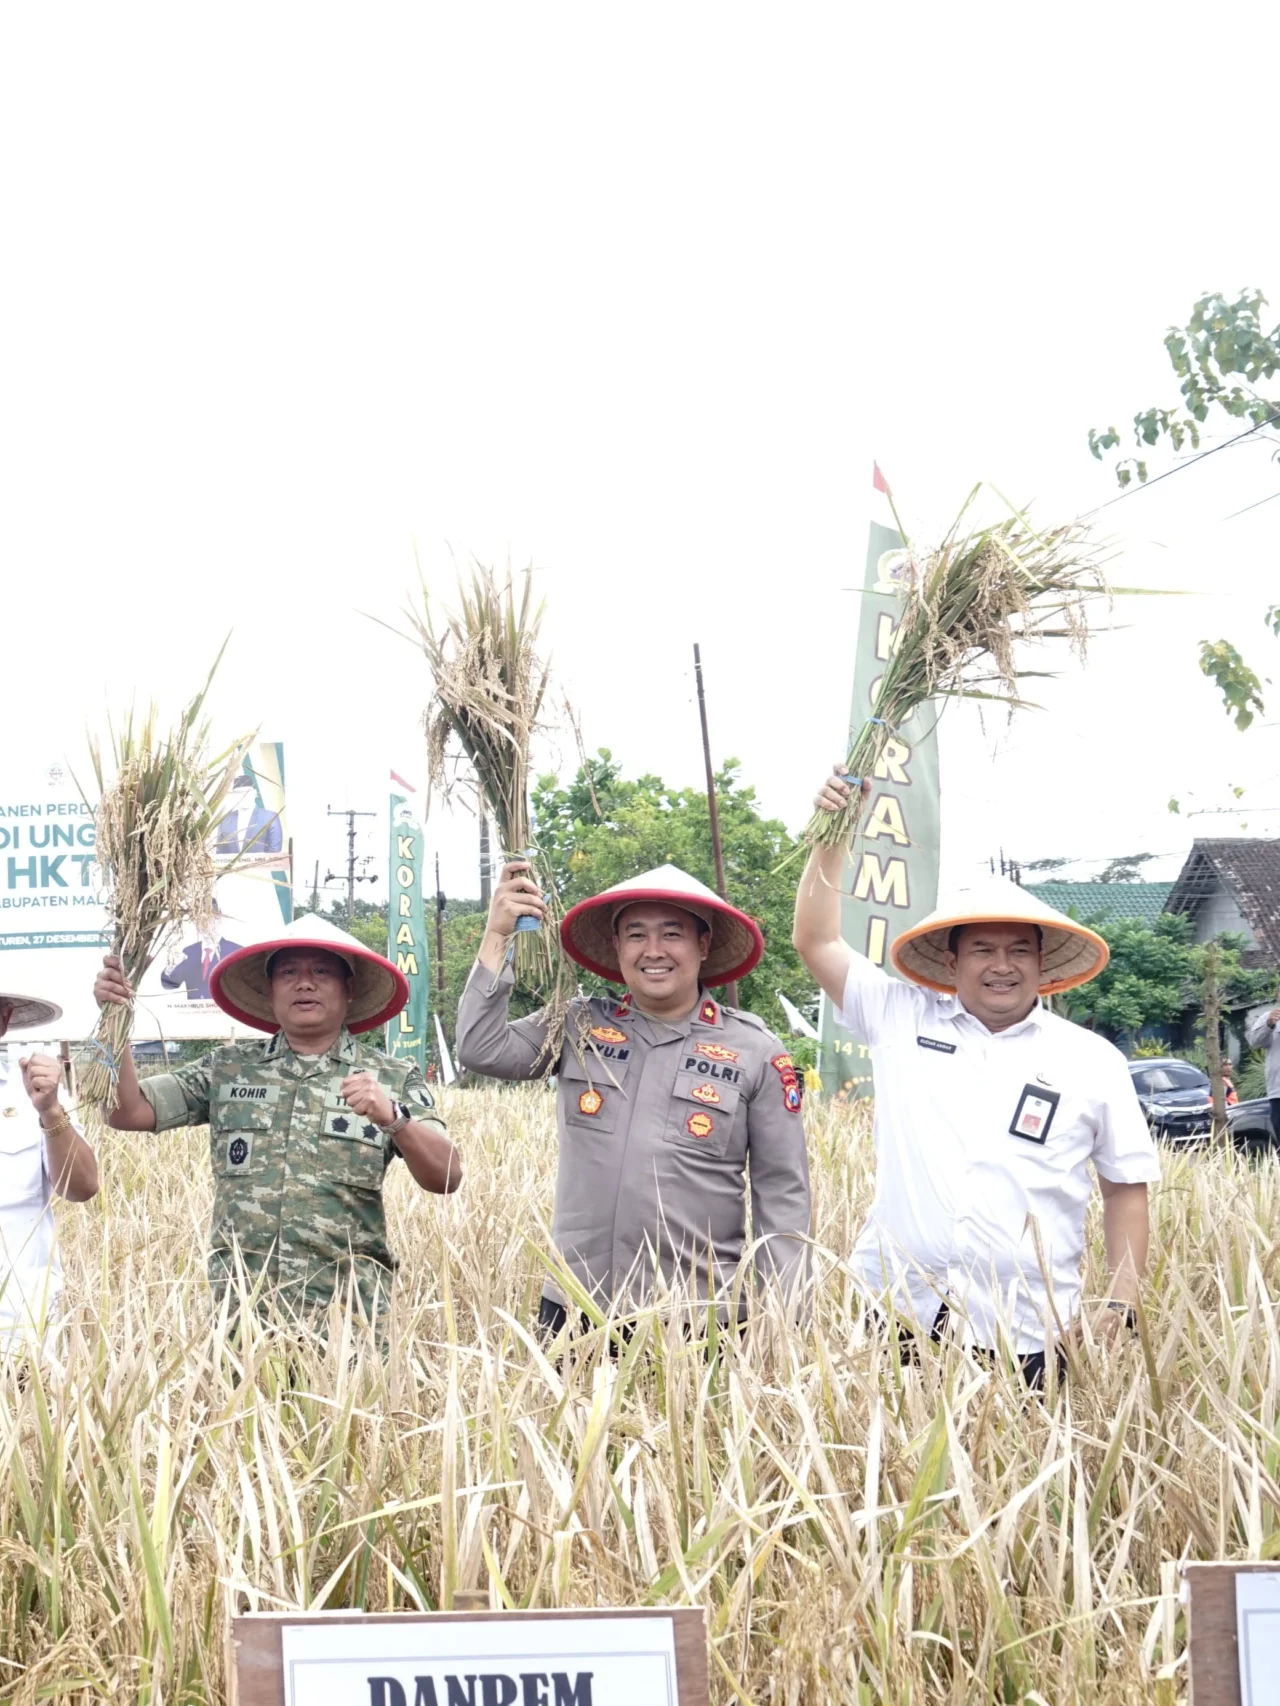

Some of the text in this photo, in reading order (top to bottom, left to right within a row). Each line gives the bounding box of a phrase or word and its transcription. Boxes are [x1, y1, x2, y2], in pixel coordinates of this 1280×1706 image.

[33, 936, 44, 944] 27
[46, 935, 100, 944] DESEMBER
[396, 834, 419, 1034] KORAML
[833, 1039, 873, 1060] 14 T
[685, 1057, 740, 1083] POLRI
[230, 1087, 267, 1098] KOHIR
